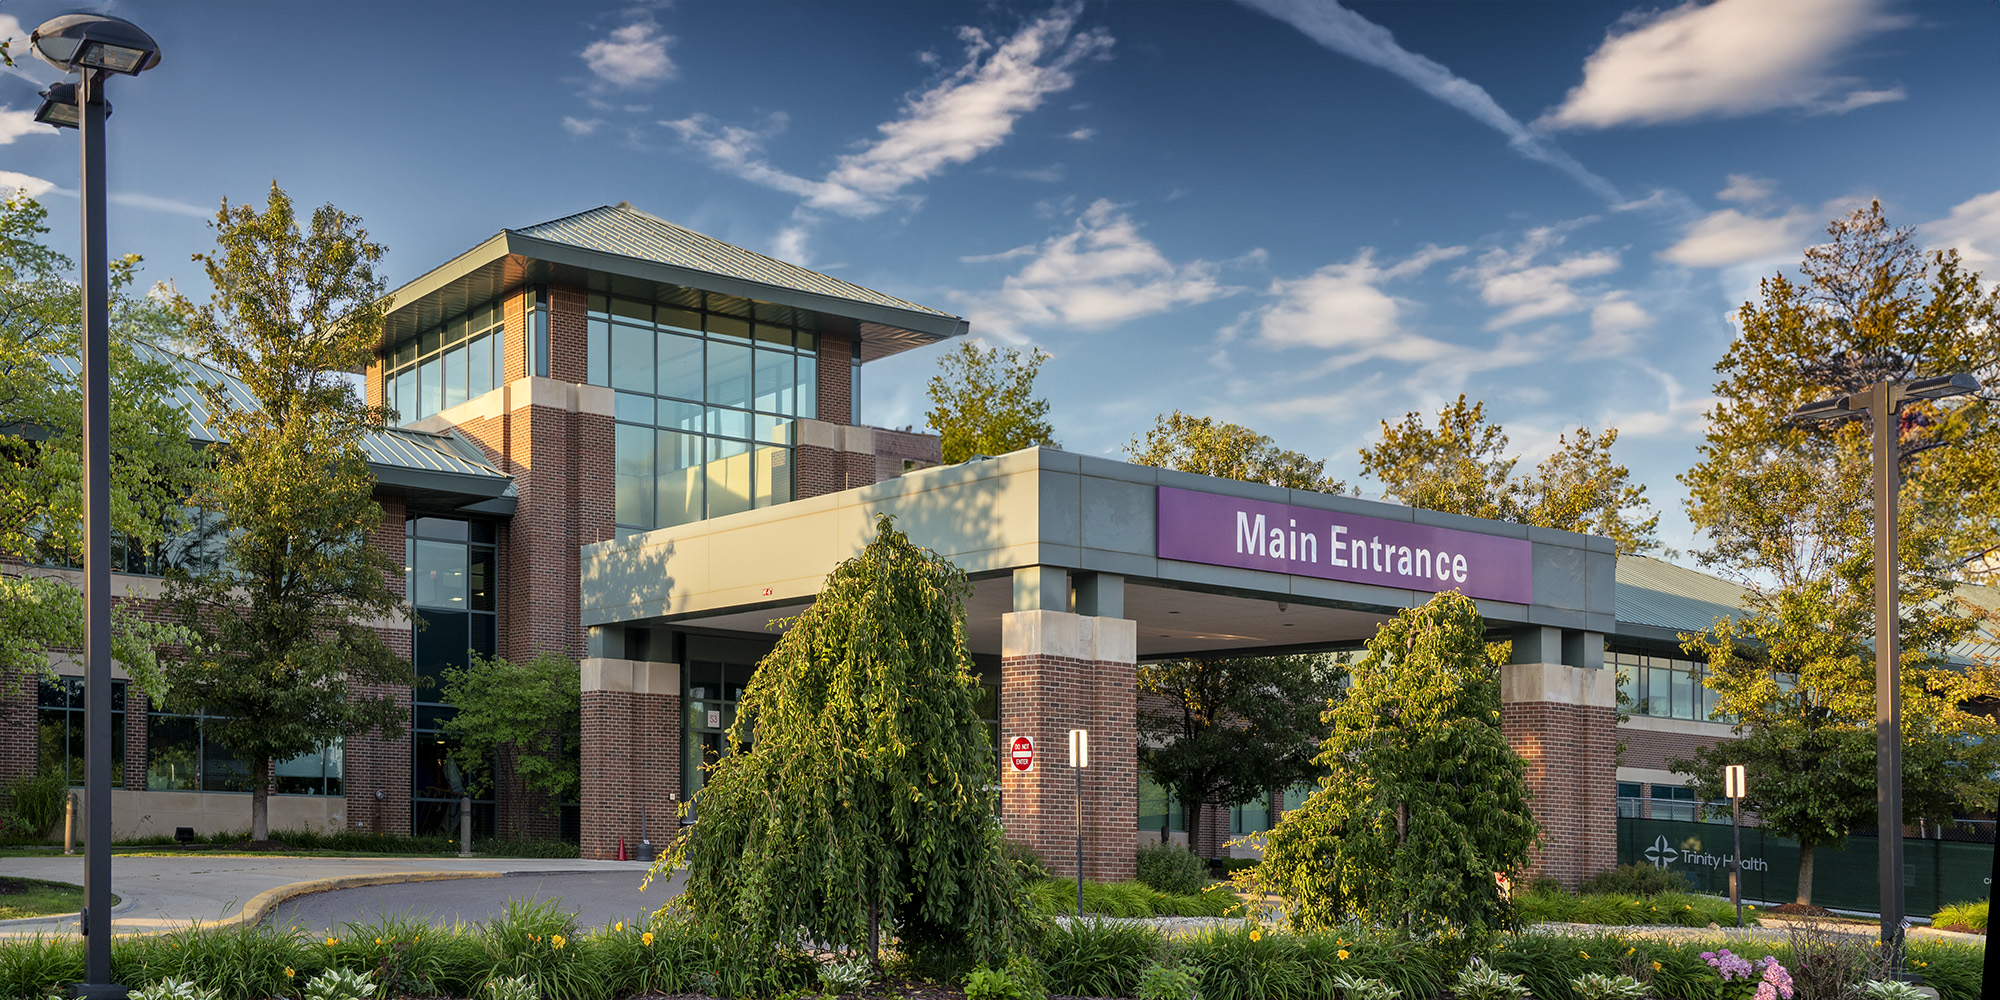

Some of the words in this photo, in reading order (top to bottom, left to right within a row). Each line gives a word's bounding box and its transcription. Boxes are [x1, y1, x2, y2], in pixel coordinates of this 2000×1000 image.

[1236, 511, 1317, 563] Main
[1331, 525, 1468, 582] Entrance
[710, 714, 717, 723] S3
[1681, 850, 1721, 870] Trinity
[1723, 854, 1768, 871] Halth
